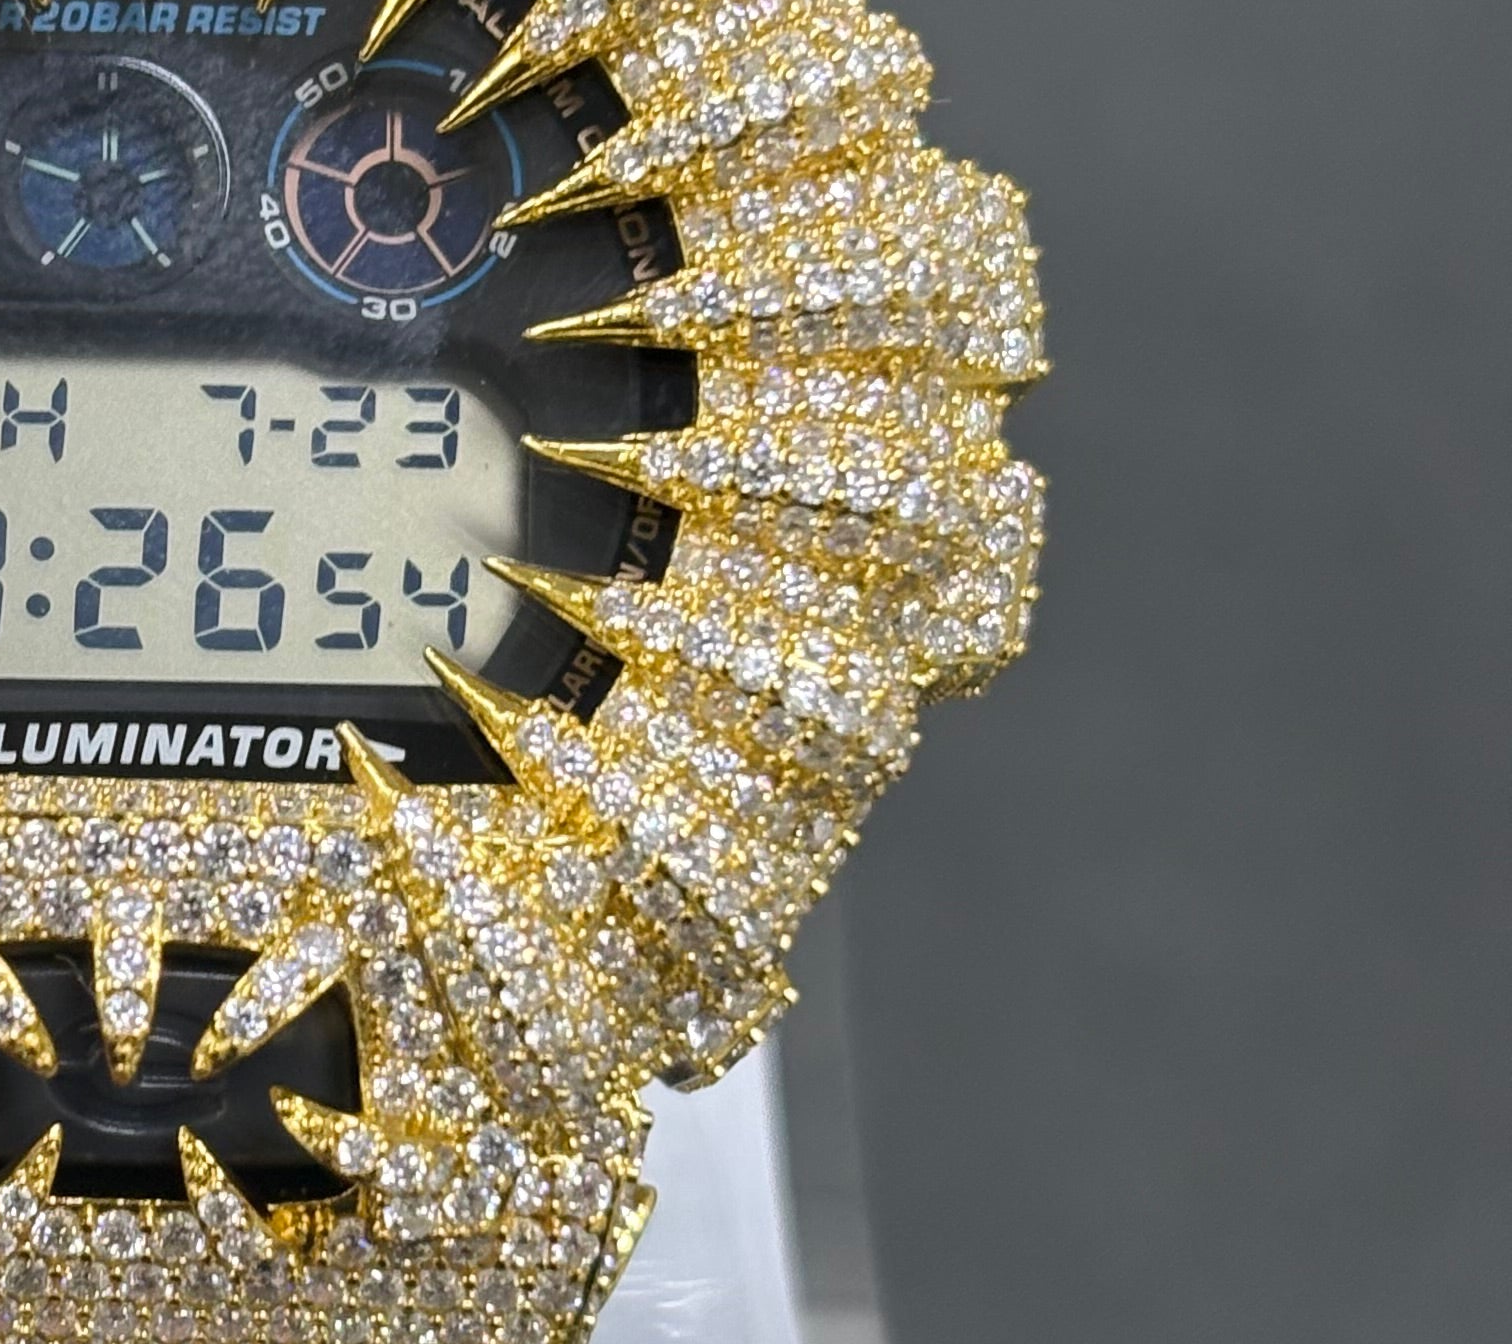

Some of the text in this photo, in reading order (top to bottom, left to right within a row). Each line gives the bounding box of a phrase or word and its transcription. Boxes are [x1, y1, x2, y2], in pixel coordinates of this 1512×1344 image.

[31, 2, 180, 35] 20BAR
[185, 6, 326, 36] RESIST
[293, 61, 350, 110] 50
[258, 192, 292, 250] 40
[360, 296, 420, 322] 30
[199, 384, 461, 470] 7-23
[314, 551, 470, 653] 54
